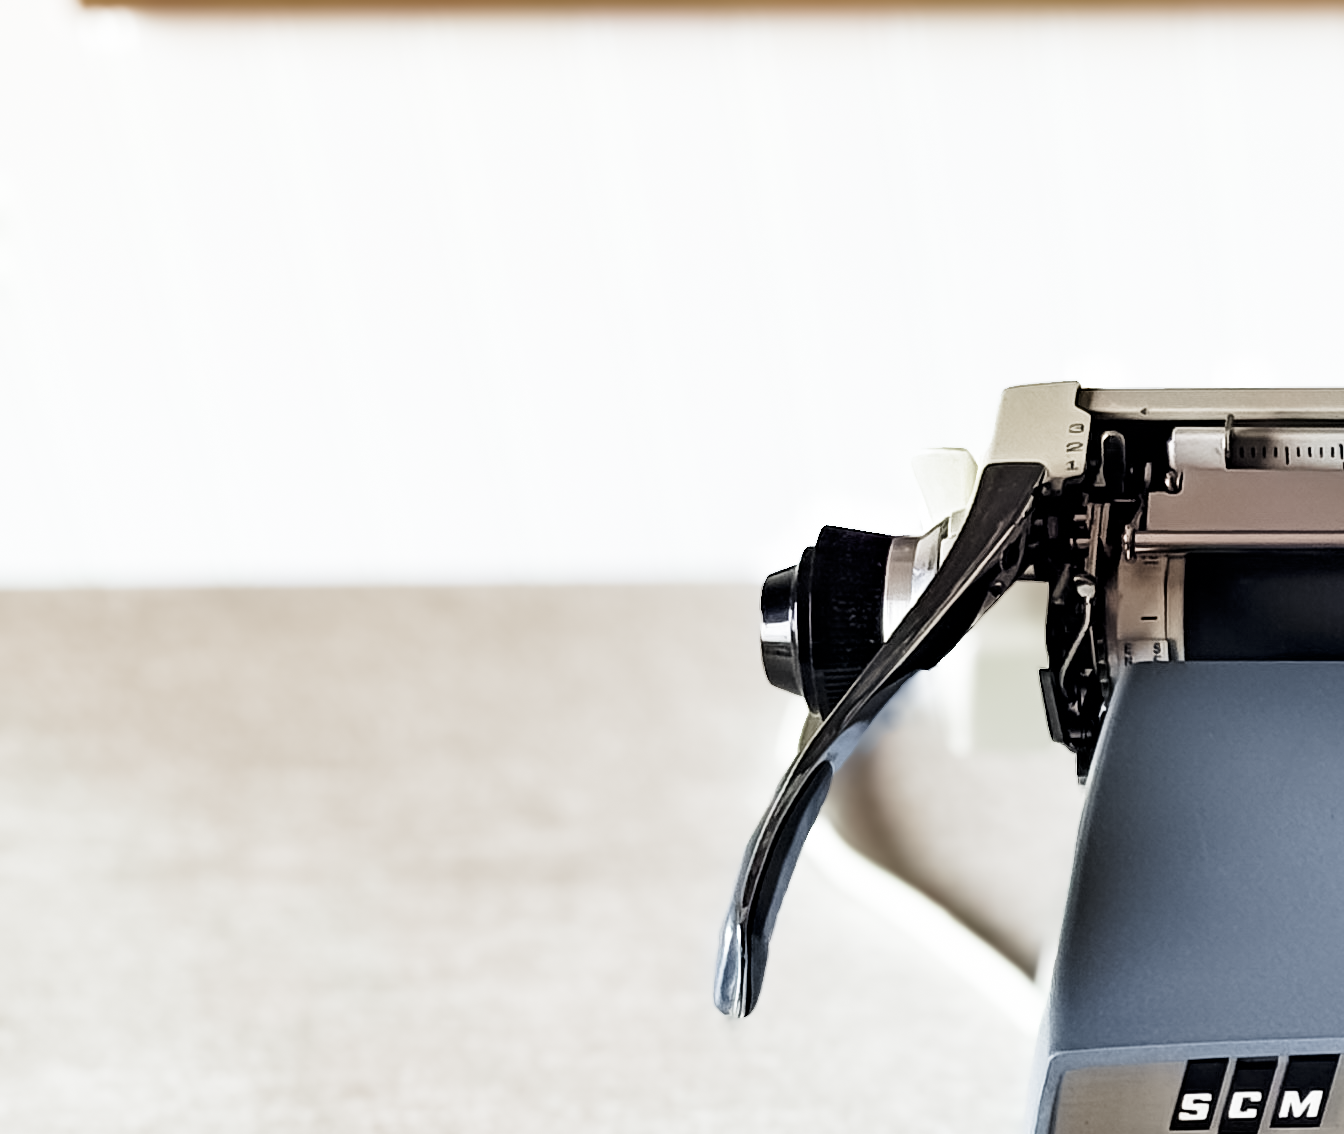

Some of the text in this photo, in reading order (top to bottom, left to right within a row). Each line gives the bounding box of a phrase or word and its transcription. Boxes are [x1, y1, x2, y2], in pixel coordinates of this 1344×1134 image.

[1065, 441, 1084, 453] 2
[1065, 459, 1080, 471] 1
[1177, 1089, 1324, 1122] SCM
